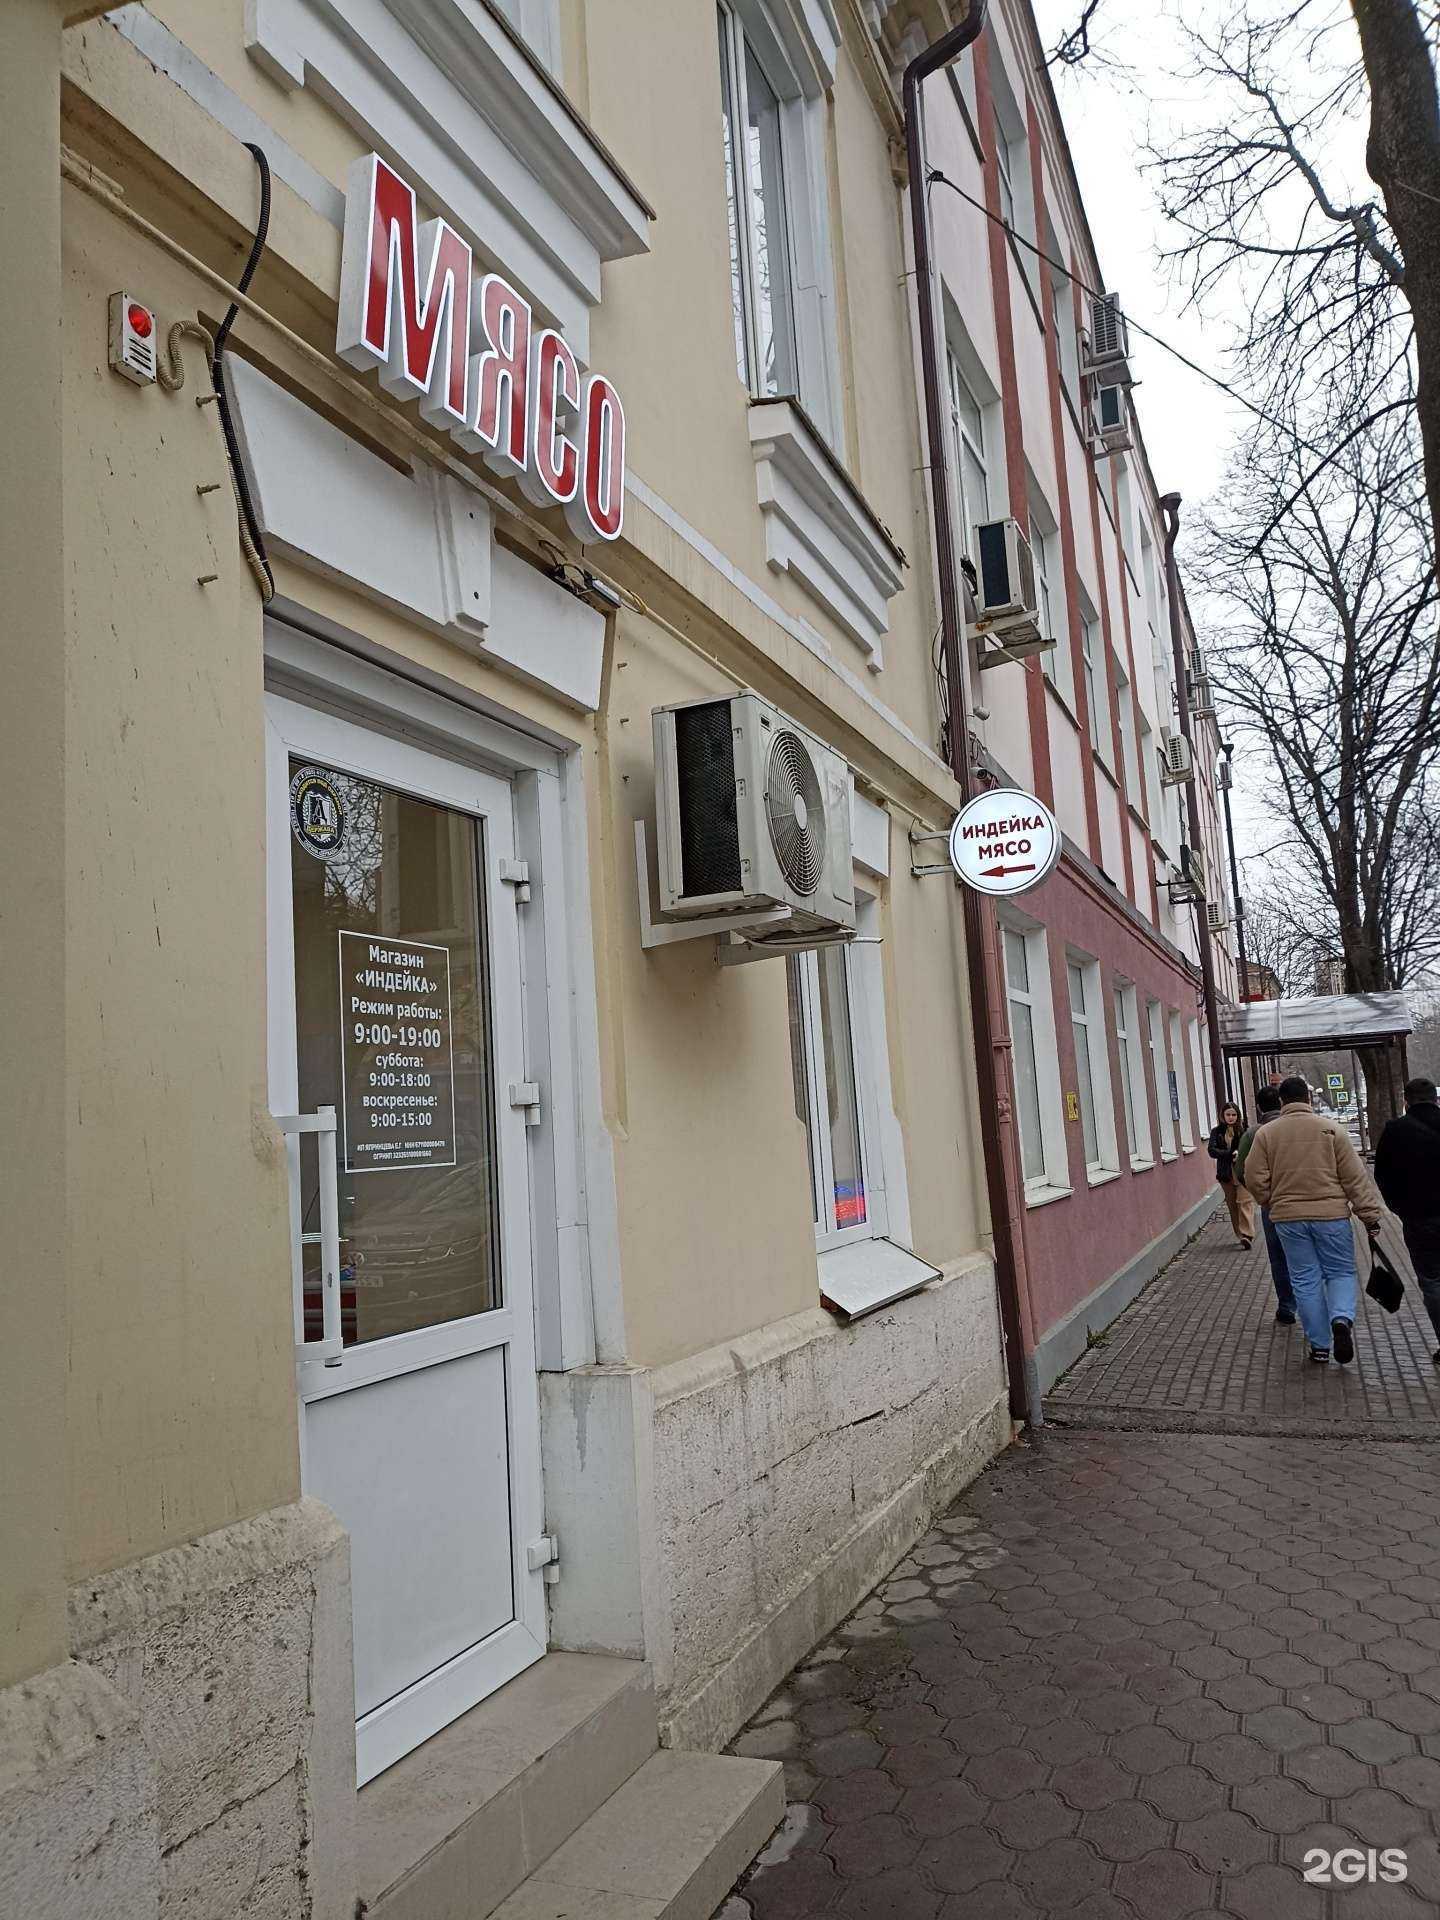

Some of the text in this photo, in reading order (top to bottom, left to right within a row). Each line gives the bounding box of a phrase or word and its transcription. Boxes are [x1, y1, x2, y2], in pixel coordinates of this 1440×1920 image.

[357, 151, 626, 541] МЯСО
[962, 814, 1045, 839] ИНДЕЙКА
[978, 839, 1032, 860] МЯСО
[369, 944, 424, 969] Магазин
[355, 970, 438, 994] «ИНДЕЙКА»
[351, 996, 442, 1020] Режим работы:
[354, 1023, 441, 1048] 9:00-19:00
[375, 1053, 424, 1069] суббота:
[369, 1072, 431, 1087] 9:00-18:00
[362, 1095, 438, 1109] воскресенье:
[370, 1112, 432, 1128] 9:00-15:00
